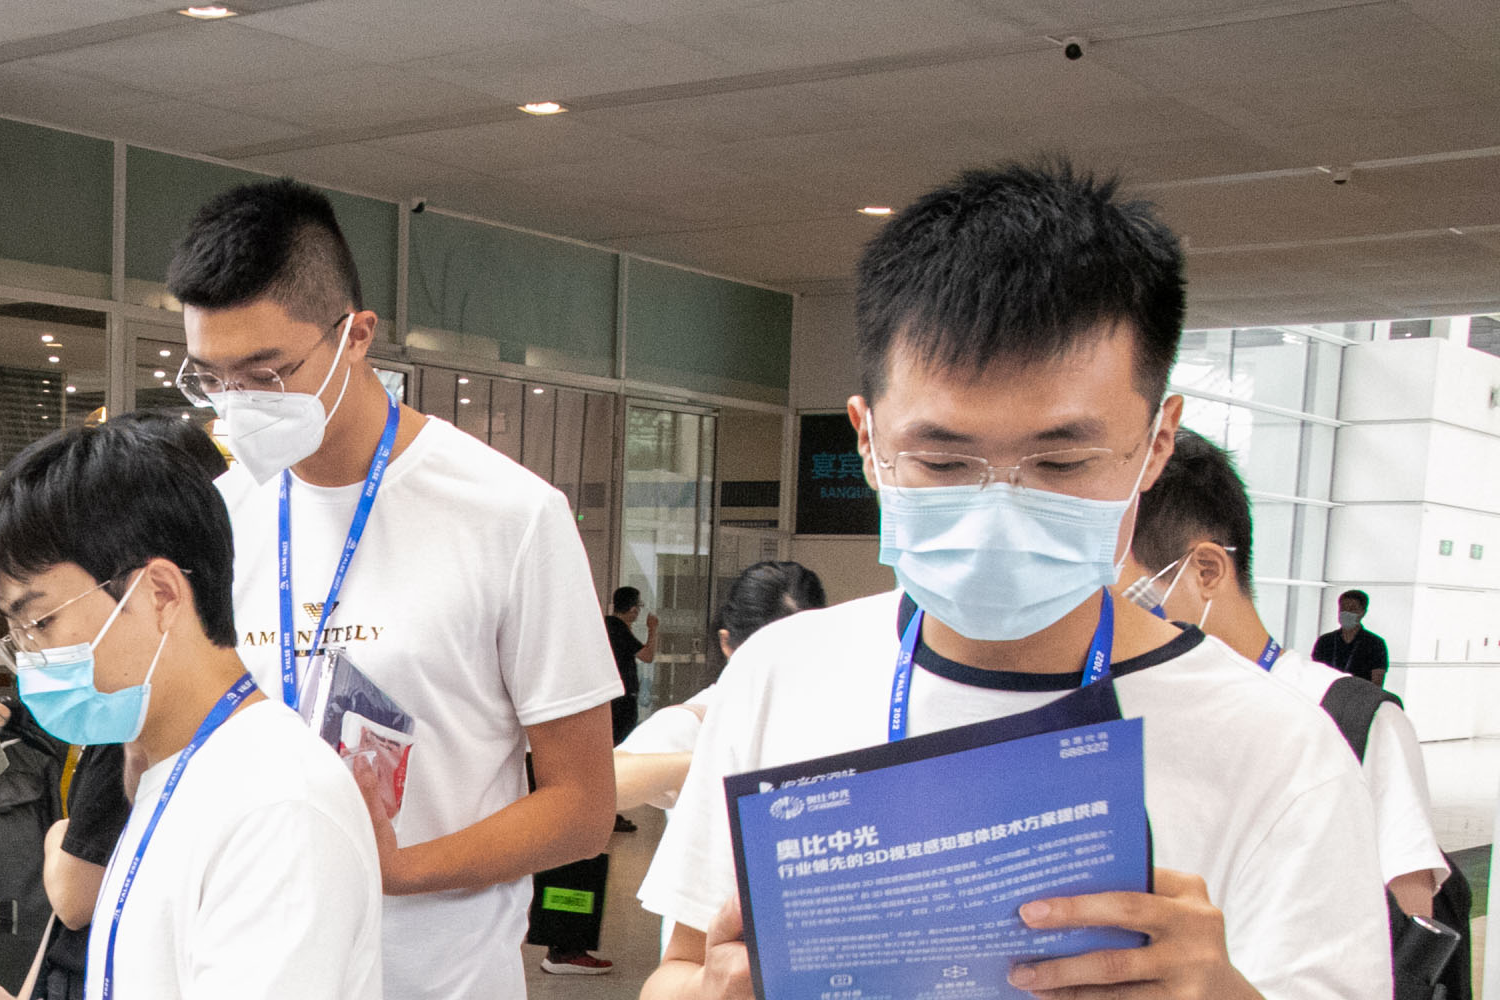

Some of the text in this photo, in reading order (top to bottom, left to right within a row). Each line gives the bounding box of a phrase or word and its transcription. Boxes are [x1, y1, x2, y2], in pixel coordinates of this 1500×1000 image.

[1093, 651, 1105, 672] 2022
[892, 672, 906, 731] VALSE 2022
[776, 826, 879, 861] 奥比中光
[777, 800, 1110, 880] 行业领先的3D视觉感知整体技术方案提供商
